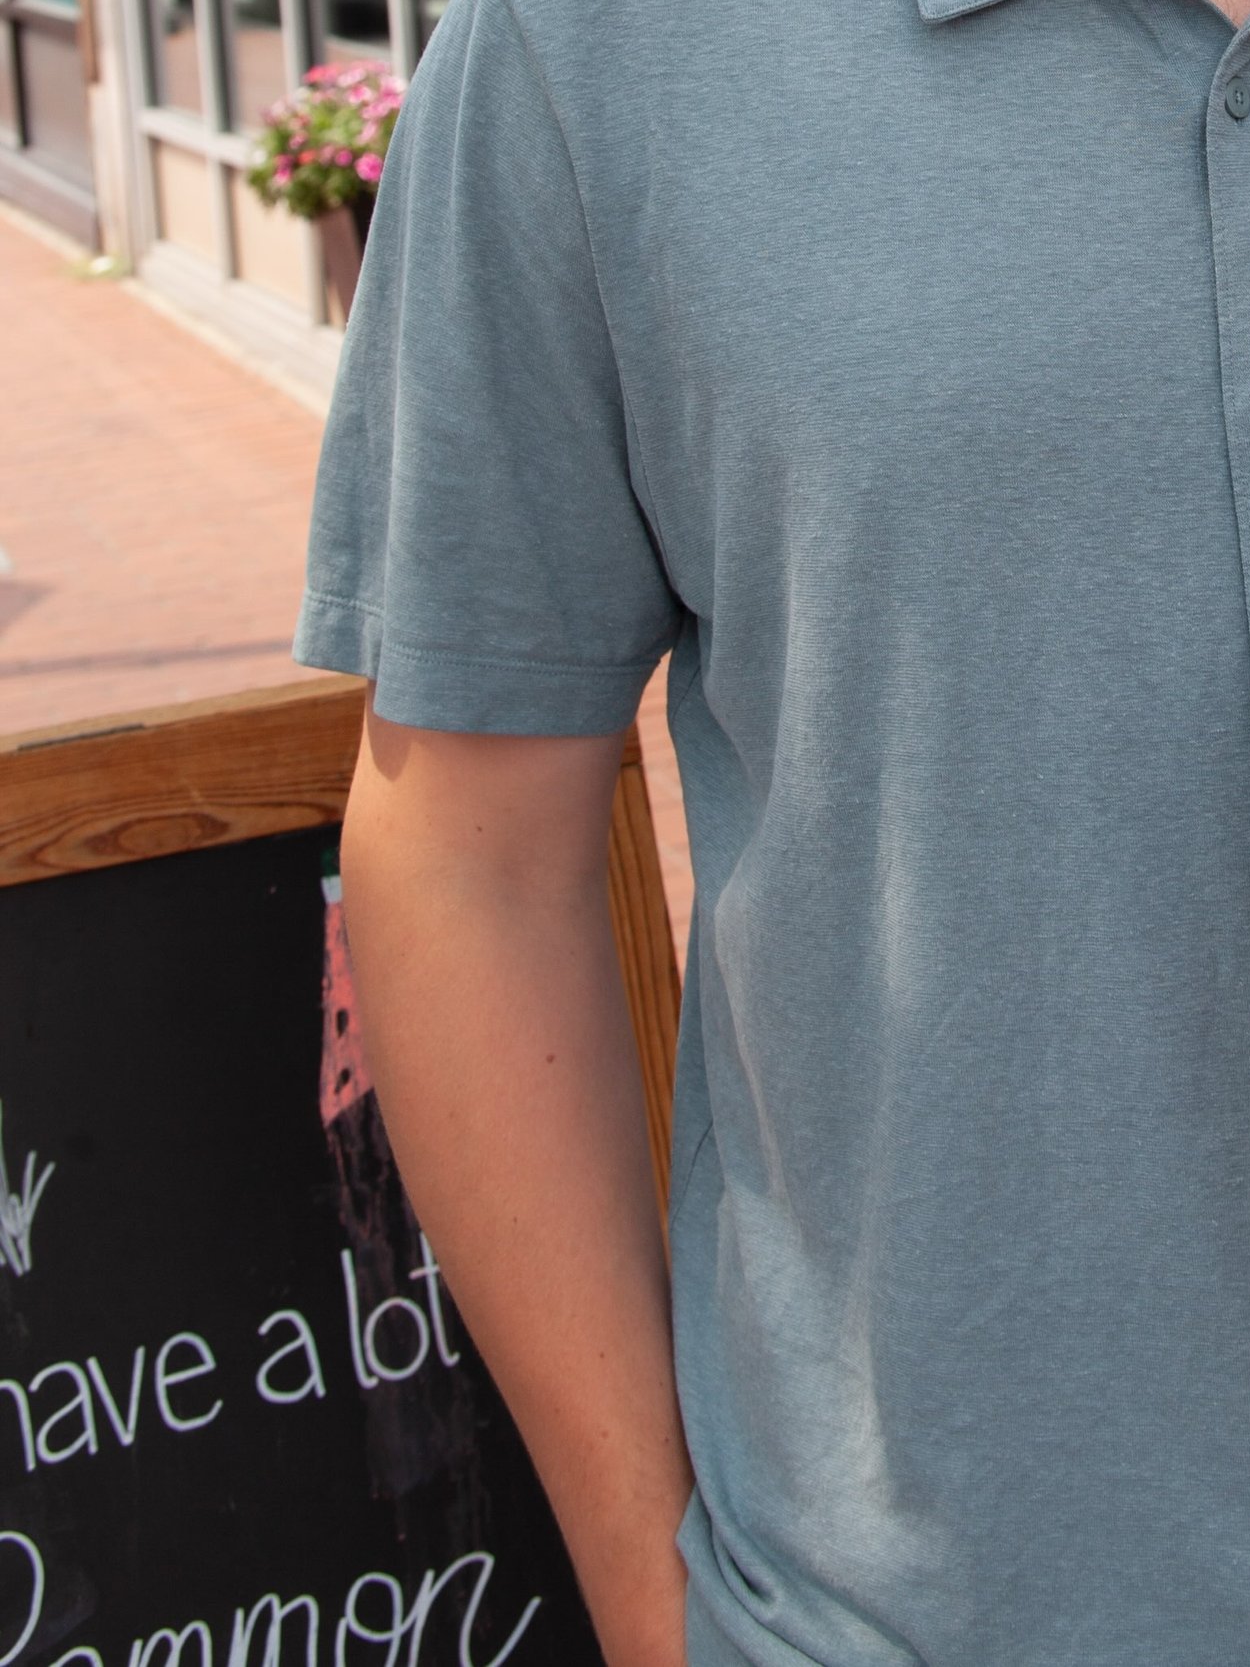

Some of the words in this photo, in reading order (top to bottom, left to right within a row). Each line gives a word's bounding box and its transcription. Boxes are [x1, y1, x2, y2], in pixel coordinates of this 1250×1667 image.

[257, 1308, 326, 1404] a
[341, 1231, 459, 1390] lot
[0, 1530, 542, 1667] mon
